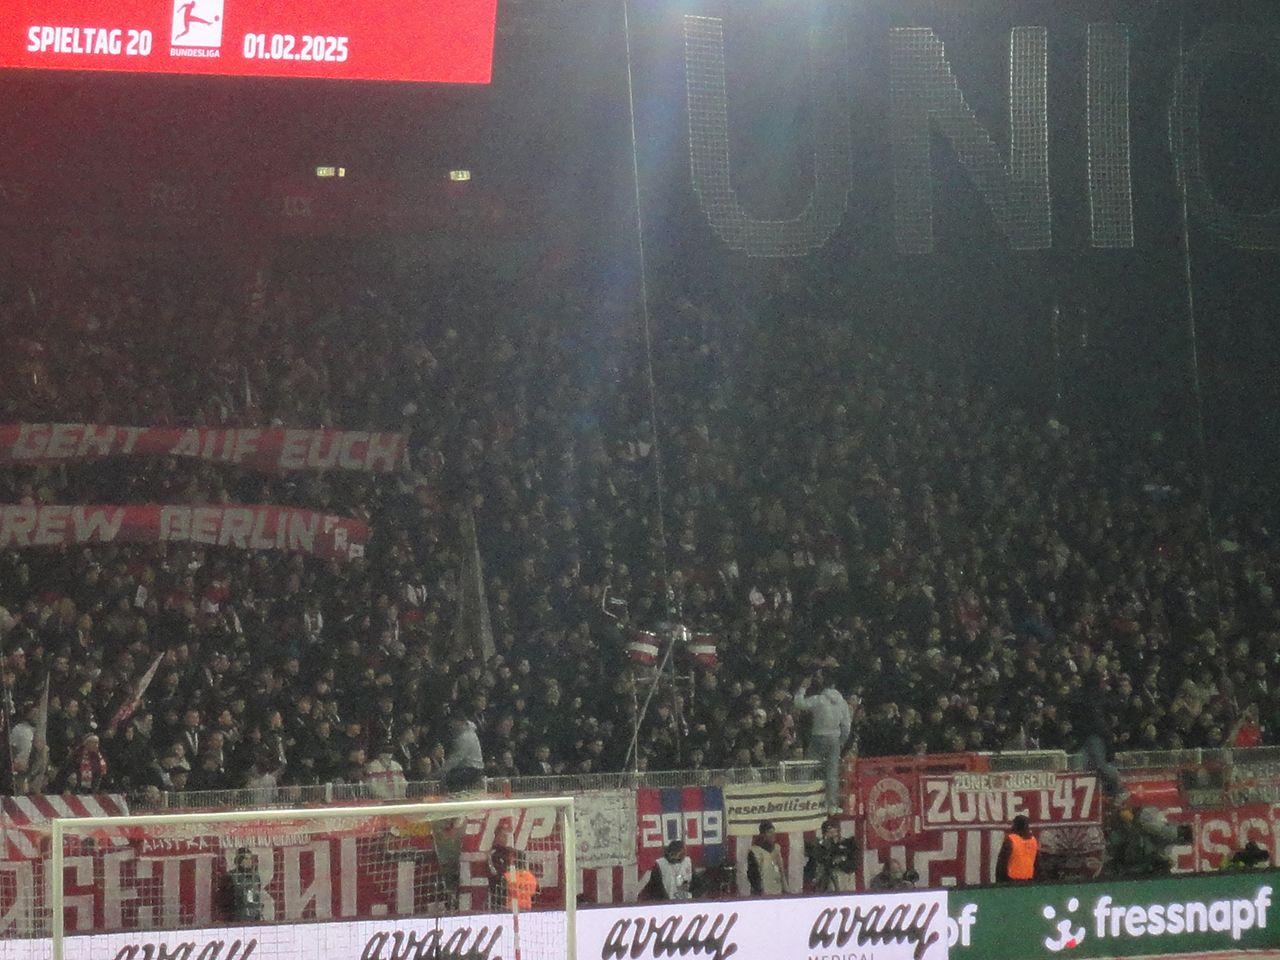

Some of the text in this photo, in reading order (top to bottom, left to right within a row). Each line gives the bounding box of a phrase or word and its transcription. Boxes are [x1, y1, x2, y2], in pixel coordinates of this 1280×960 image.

[27, 26, 152, 56] SPIELTAG 20
[170, 48, 220, 58] BUNDESLIGA
[244, 33, 348, 62] 01.02.2025
[157, 505, 319, 551] BERLIN
[927, 780, 1030, 823] ZONE
[642, 810, 723, 848] 2009
[808, 902, 940, 960] avaay
[1094, 886, 1274, 940] fressnapf
[600, 912, 739, 960] avaay
